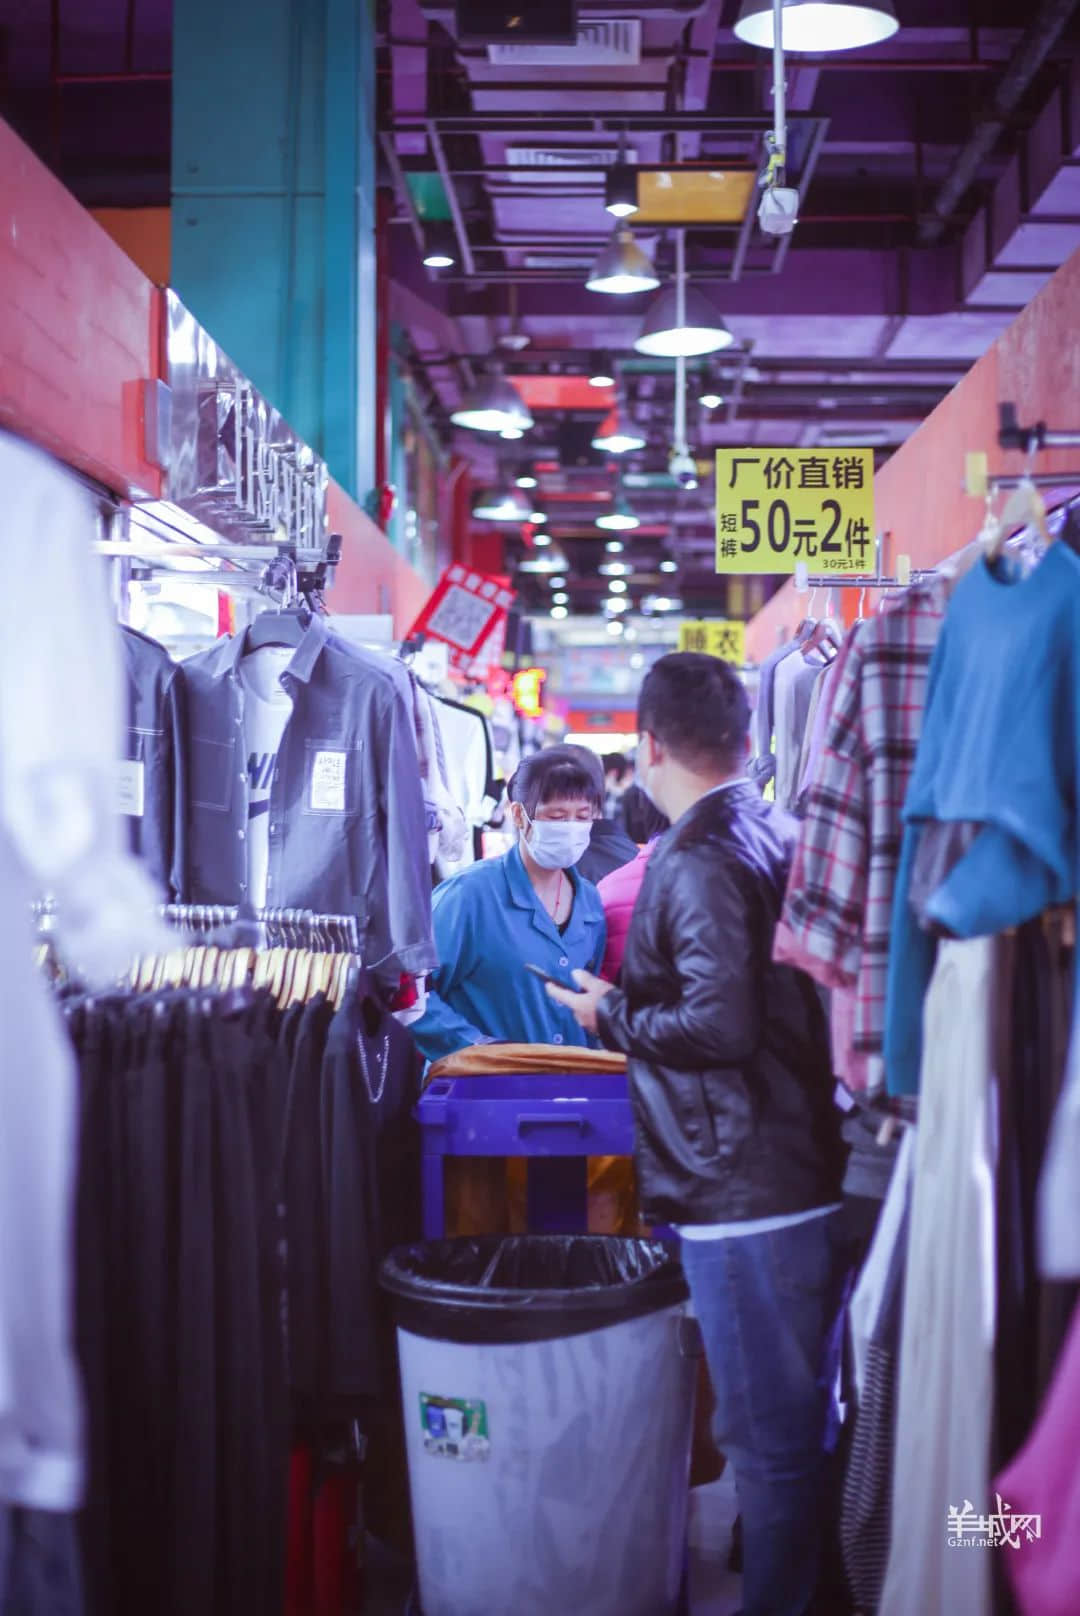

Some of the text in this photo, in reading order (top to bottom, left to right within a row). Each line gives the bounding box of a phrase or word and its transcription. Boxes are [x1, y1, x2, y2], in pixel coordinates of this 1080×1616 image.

[729, 456, 864, 489] 厂价直销
[721, 513, 737, 557] 短裤
[740, 499, 870, 557] 50元2件
[822, 559, 866, 568] 30元1件
